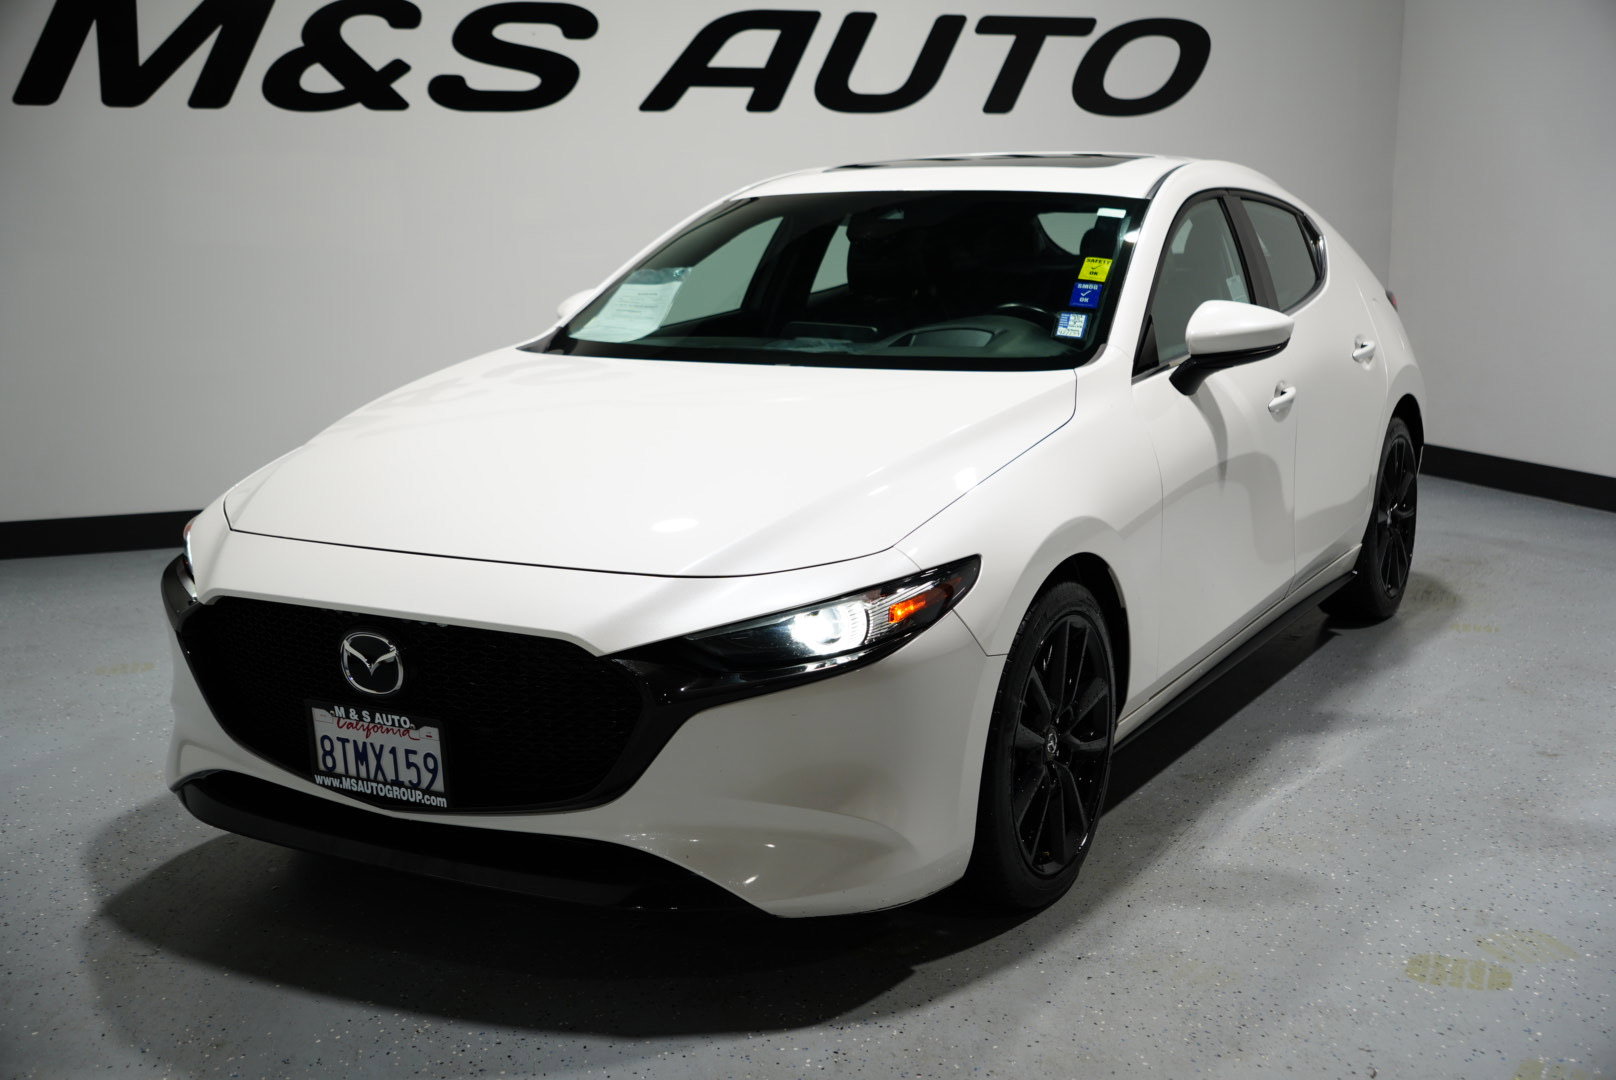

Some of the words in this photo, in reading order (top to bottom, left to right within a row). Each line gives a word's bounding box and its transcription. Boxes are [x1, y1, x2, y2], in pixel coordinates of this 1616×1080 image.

[12, 0, 599, 112] M&S
[638, 9, 1212, 117] AUTO
[334, 705, 346, 718] M
[349, 708, 359, 720] &
[362, 710, 371, 723] S
[374, 712, 410, 728] AUTO
[336, 717, 420, 740] California
[320, 734, 439, 791] 8TMX159
[314, 774, 448, 808] www.MSAUTOGROUP.com
